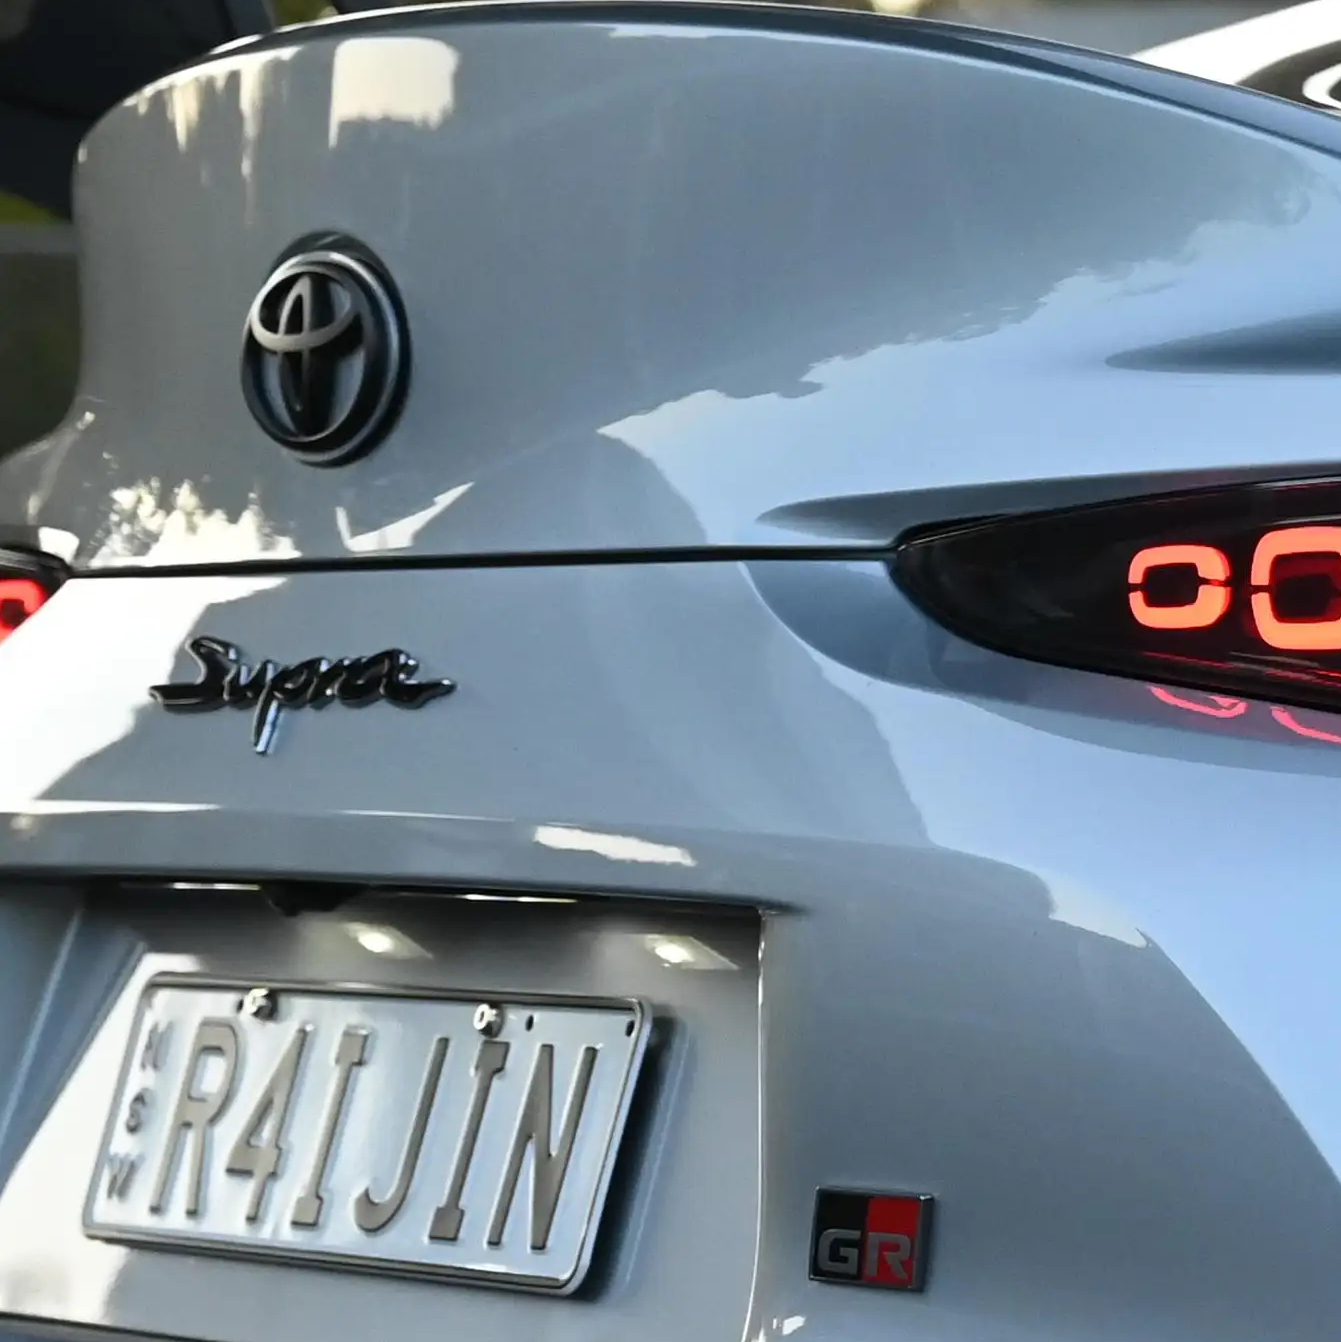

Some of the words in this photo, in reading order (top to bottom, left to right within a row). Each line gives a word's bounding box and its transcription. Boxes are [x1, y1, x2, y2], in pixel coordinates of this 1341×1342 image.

[149, 635, 457, 756] Supra
[148, 1015, 601, 1253] R4IJIN
[816, 1227, 912, 1280] GR
